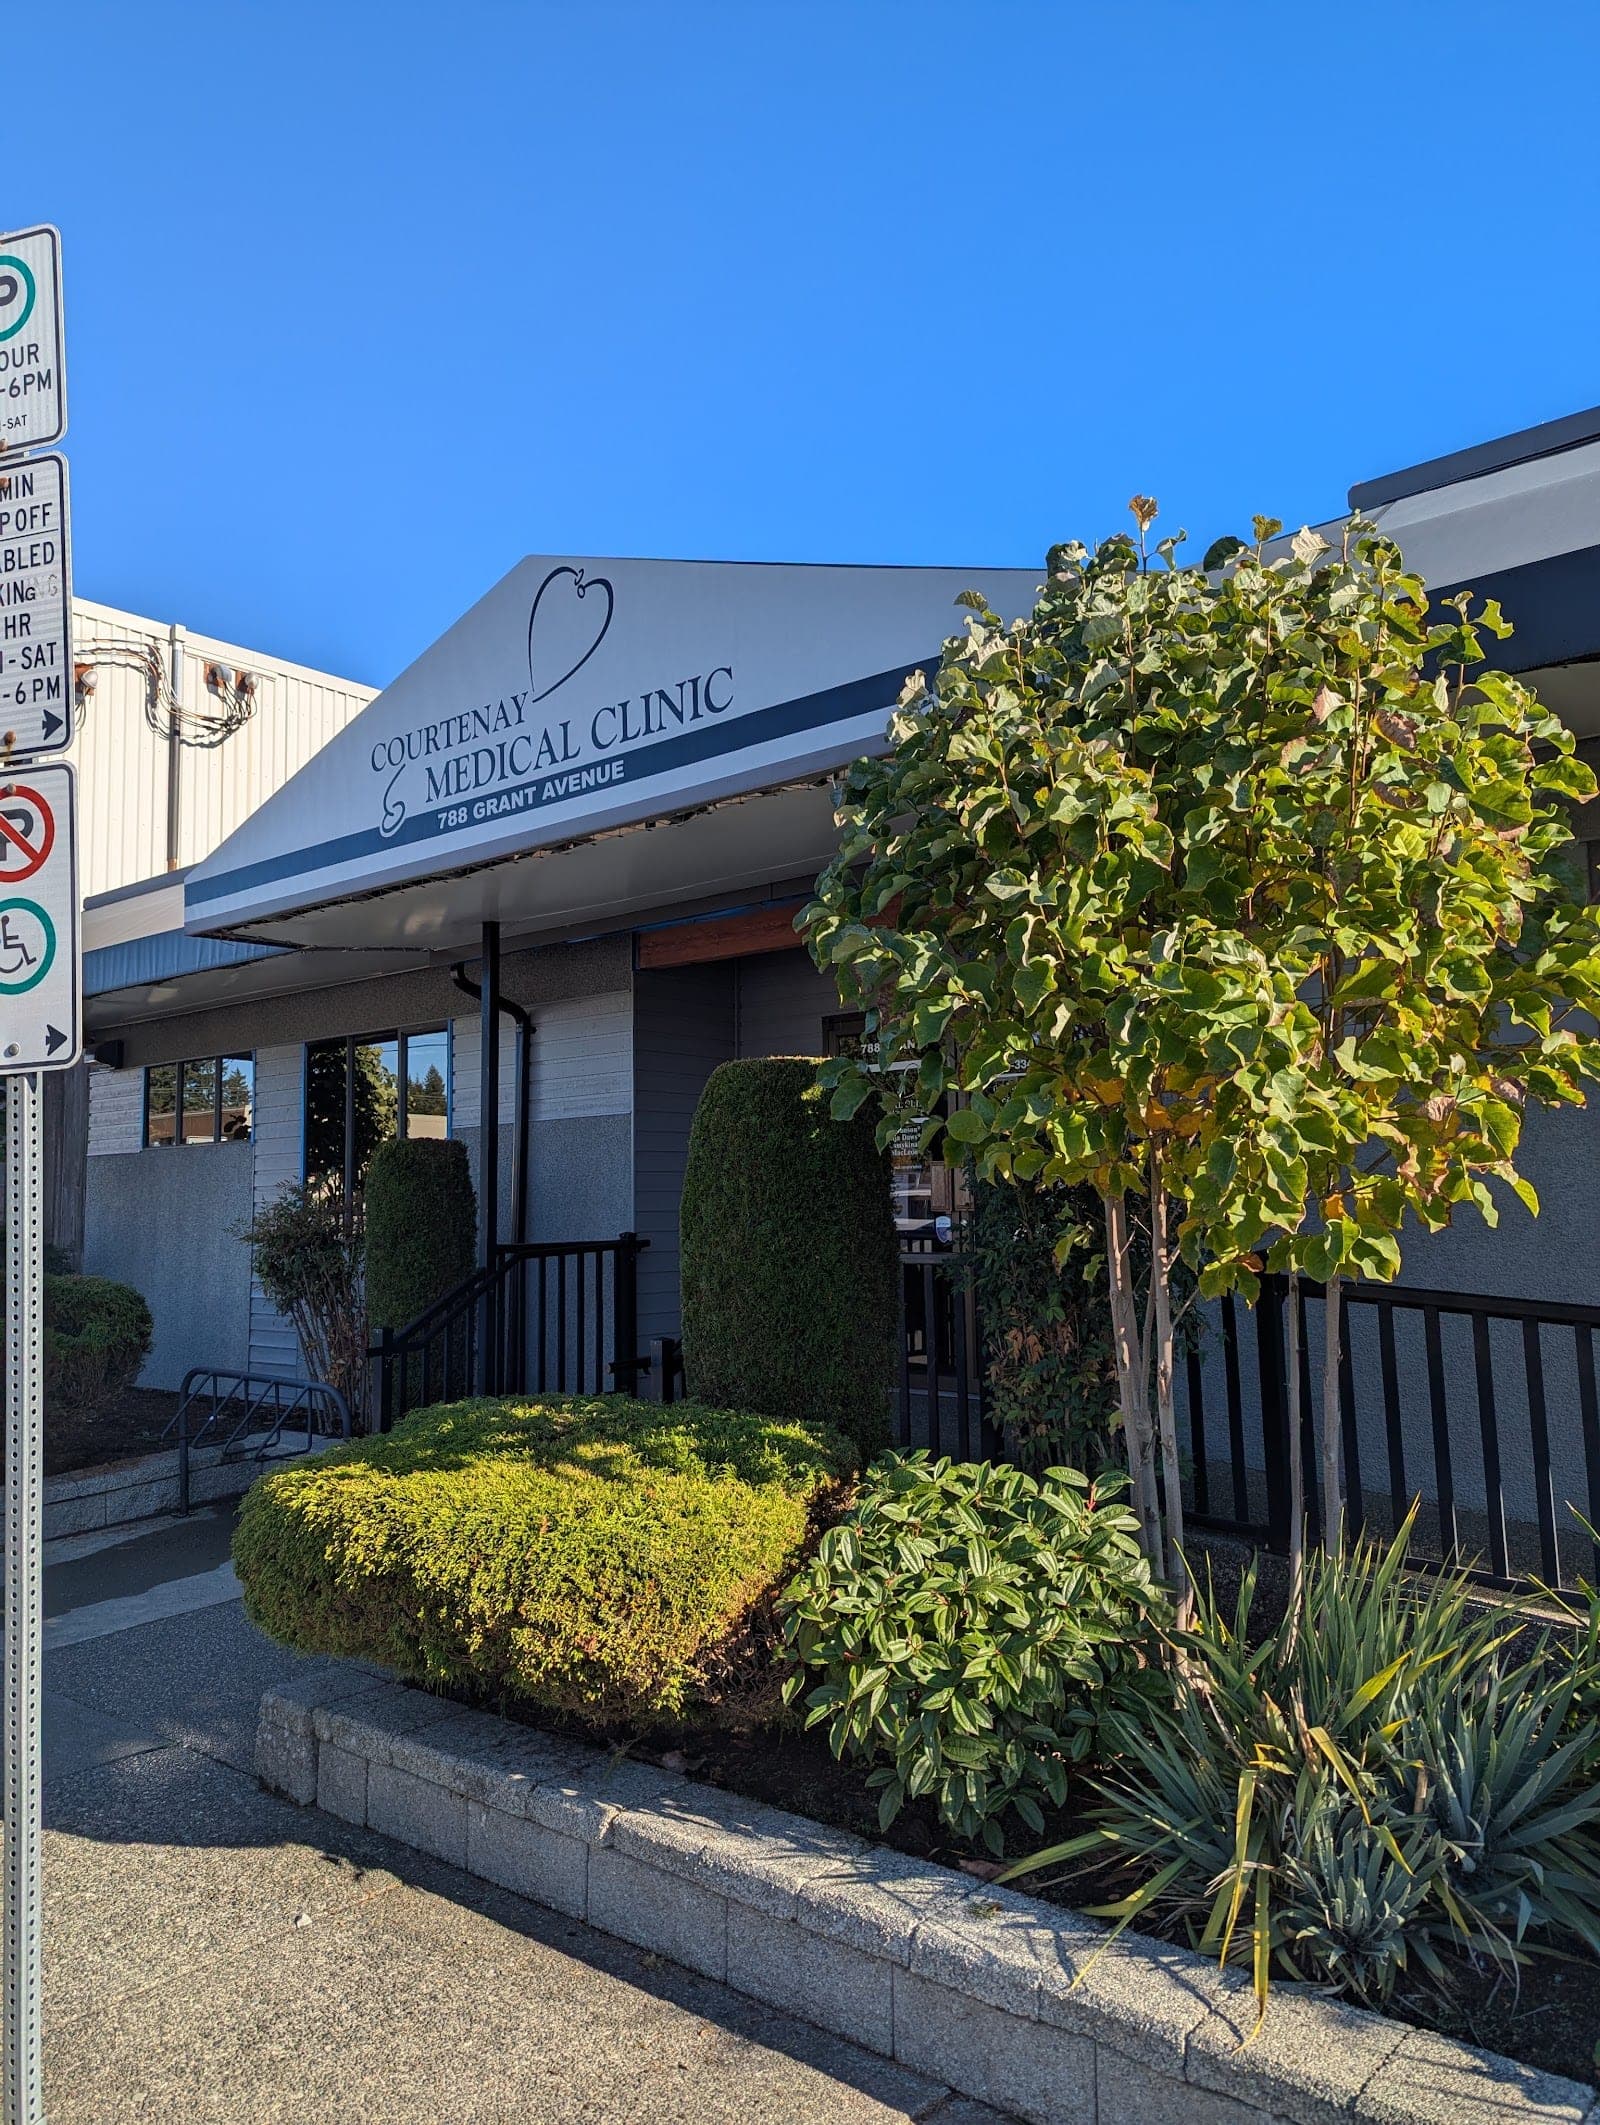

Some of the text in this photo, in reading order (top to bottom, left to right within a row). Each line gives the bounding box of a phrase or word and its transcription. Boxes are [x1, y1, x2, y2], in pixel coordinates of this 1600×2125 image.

[0, 414, 27, 432] -SAT
[0, 541, 55, 574] BLED
[5, 613, 31, 640] HR
[371, 691, 528, 772] COURTENAY
[424, 666, 734, 804] MEDICAL CLINIC
[437, 759, 625, 830] 788 GRANT AVENUE
[860, 1043, 880, 1054] 788
